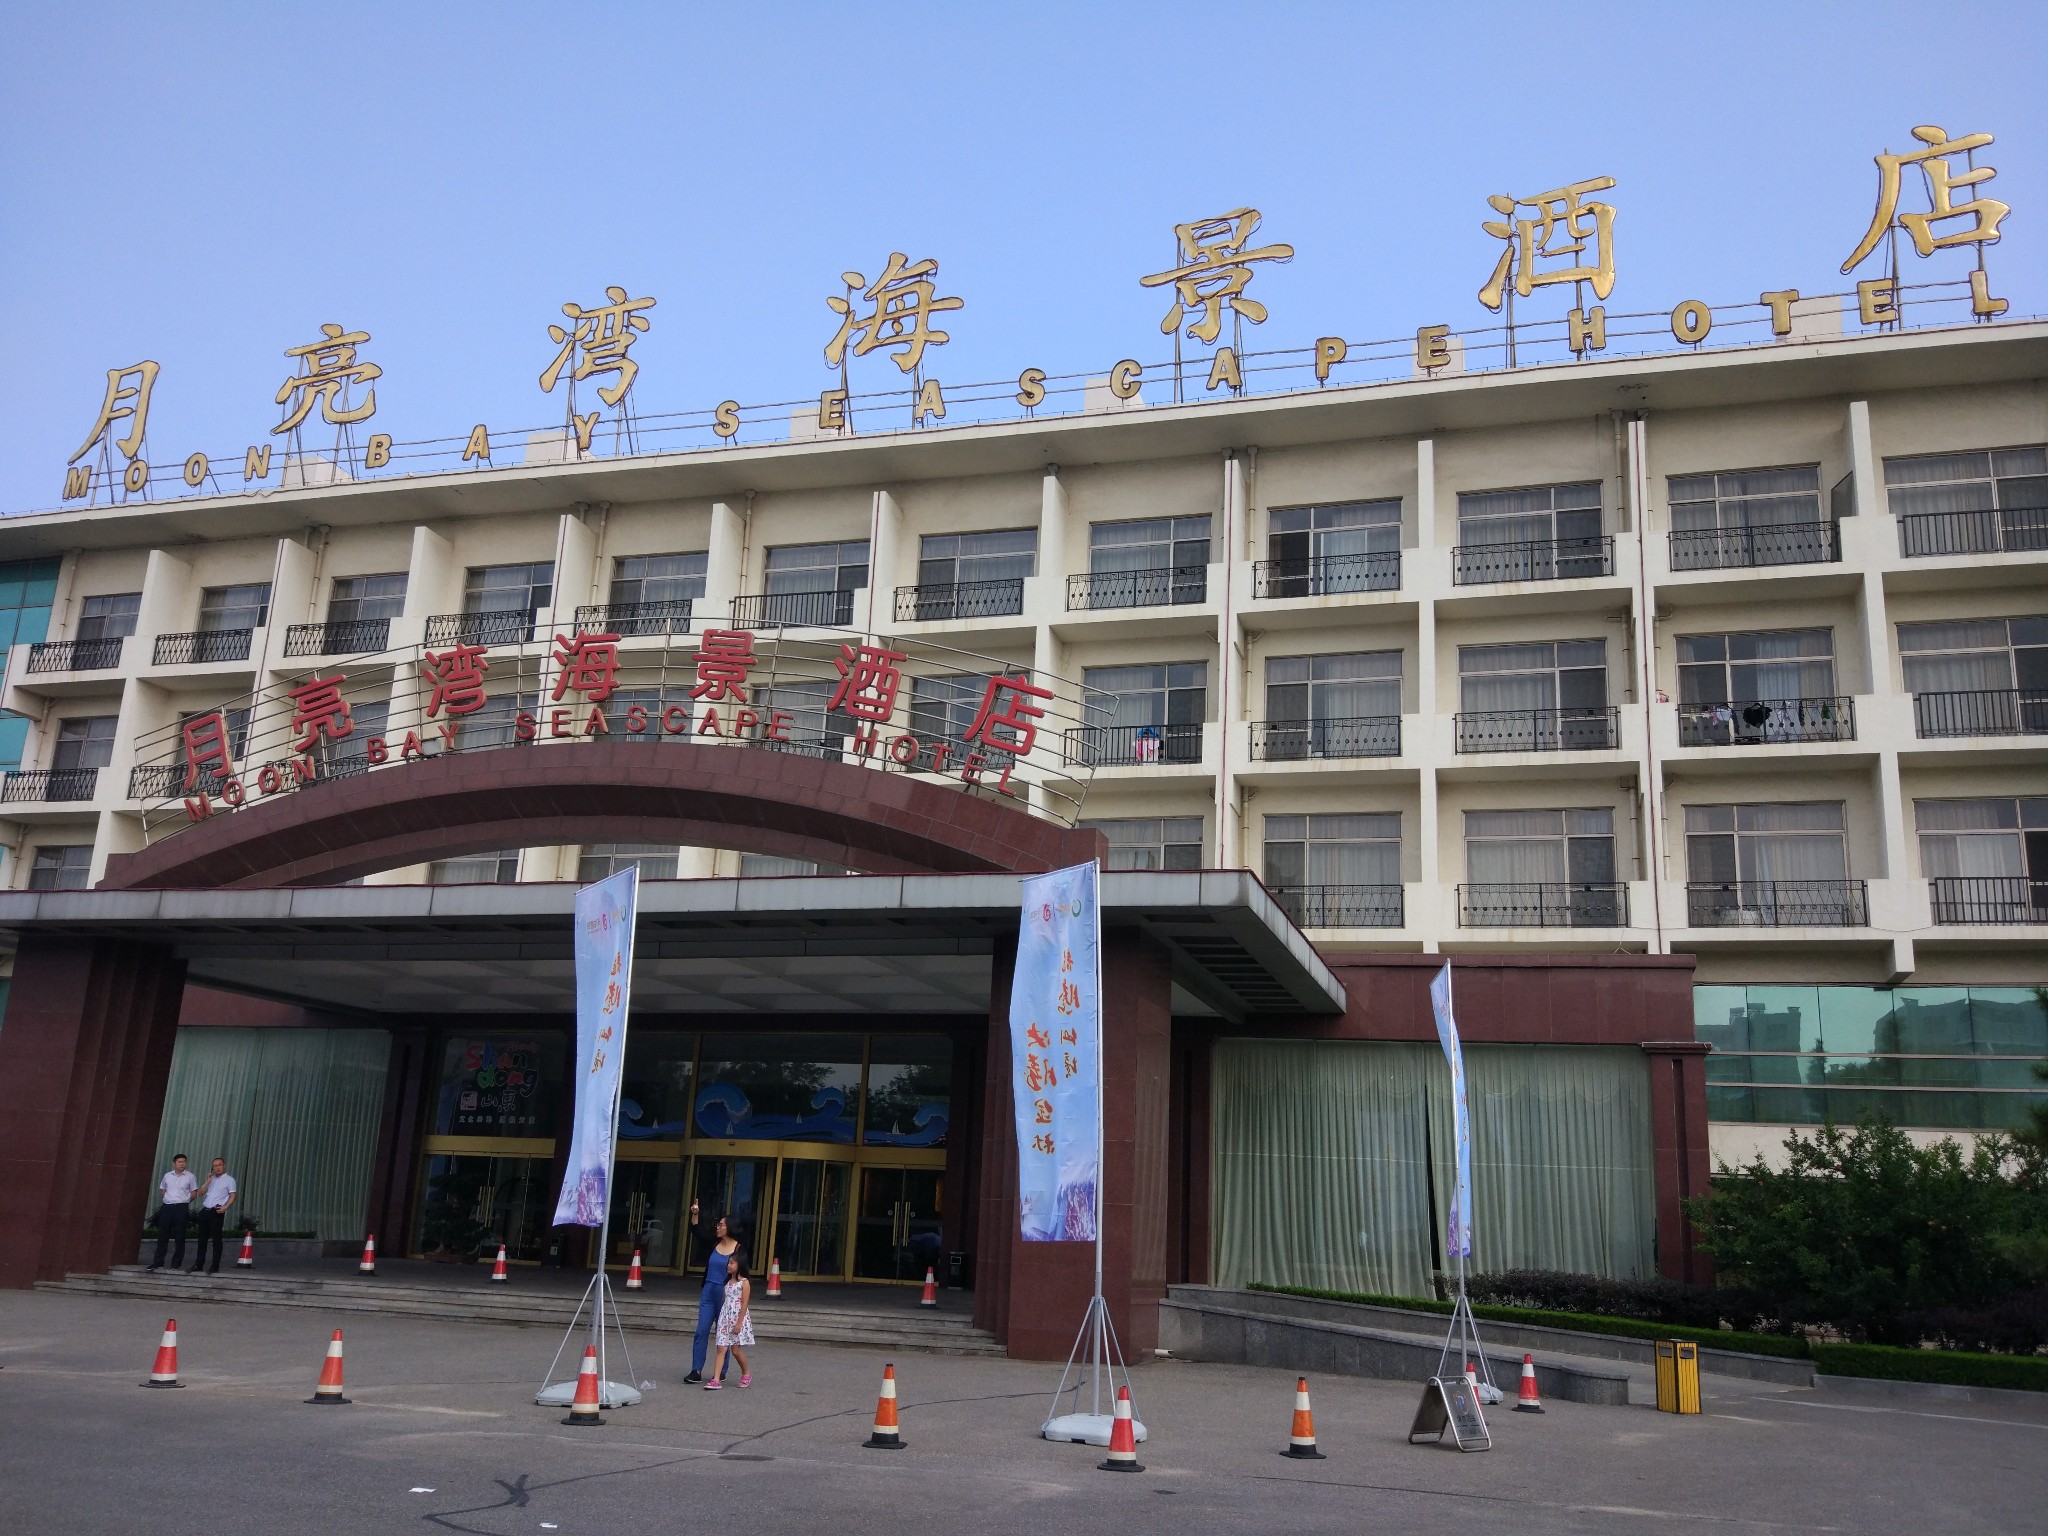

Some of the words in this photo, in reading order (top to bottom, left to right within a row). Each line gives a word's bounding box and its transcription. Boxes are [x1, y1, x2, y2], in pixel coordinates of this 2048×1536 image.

[62, 444, 272, 500] MOON
[365, 411, 600, 468] BAY
[713, 324, 1451, 438] SEASCAPE
[1568, 270, 2010, 352] HOTEL
[67, 125, 2011, 465] 月亮湾海景酒店
[183, 628, 1055, 791] 月亮湾海景酒店
[184, 755, 316, 823] MOON
[367, 722, 459, 764] BAY
[515, 705, 794, 741] SEASCAPE
[853, 726, 1016, 797] HOTEL
